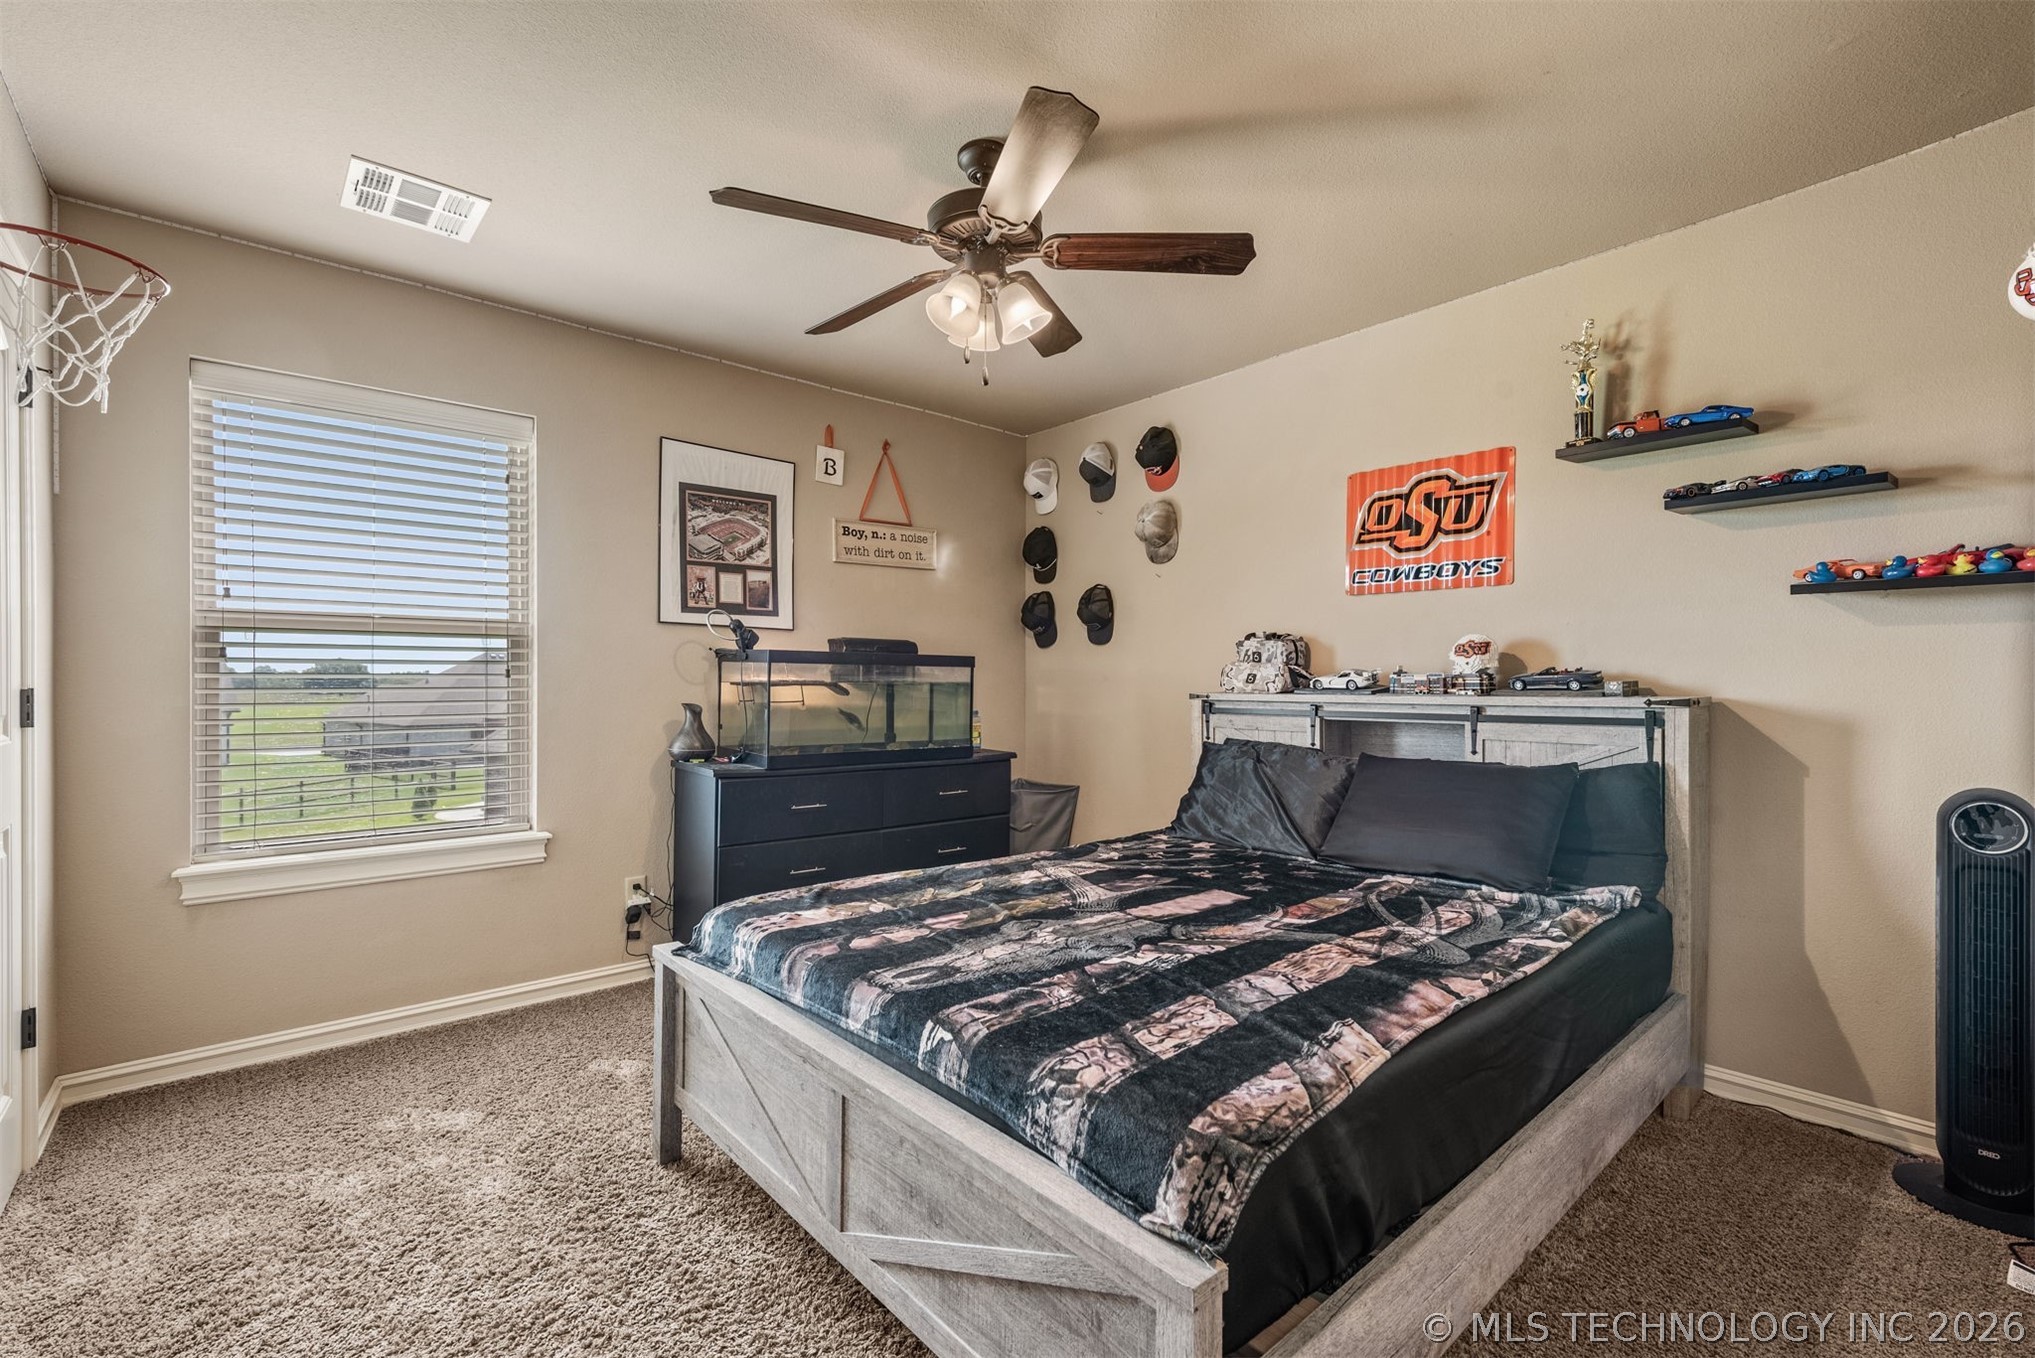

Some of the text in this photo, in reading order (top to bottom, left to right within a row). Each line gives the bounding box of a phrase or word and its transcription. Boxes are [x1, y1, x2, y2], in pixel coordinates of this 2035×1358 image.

[823, 457, 837, 477] B
[1355, 472, 1500, 554] OSU
[841, 525, 929, 544] Boy, n.: a noise
[843, 545, 926, 561] with dirt on it.
[1351, 556, 1504, 586] COWBOYS
